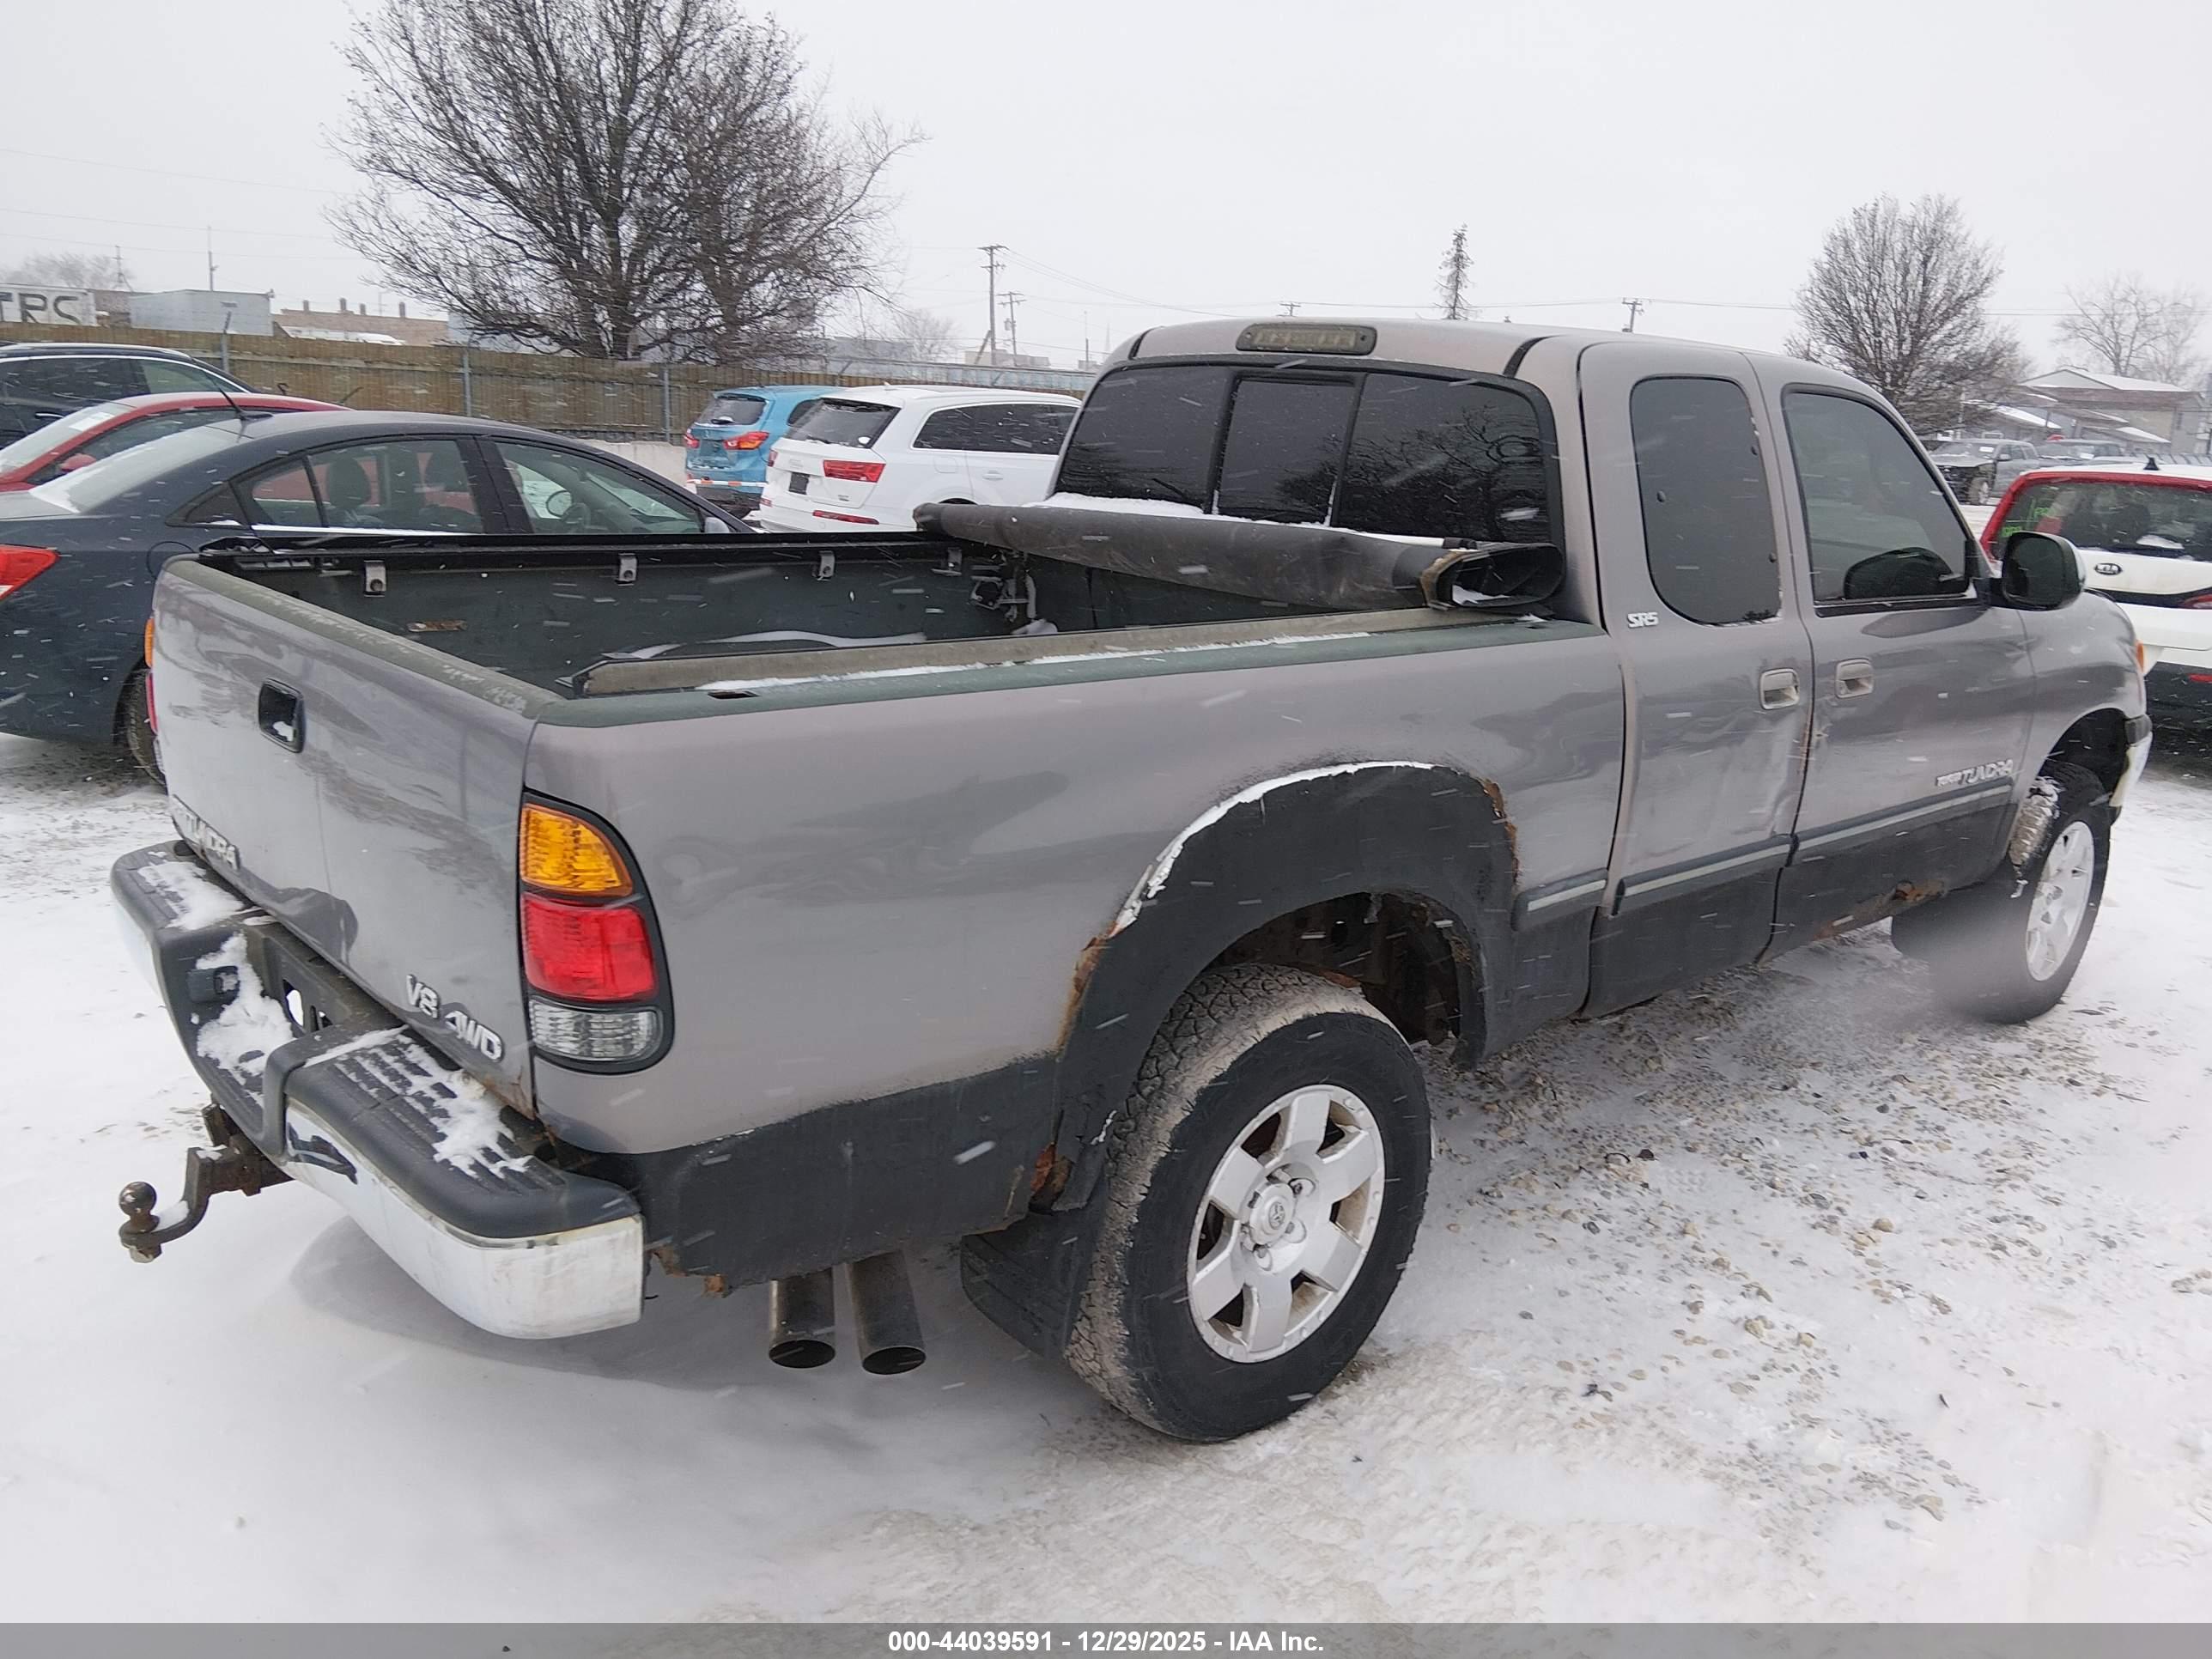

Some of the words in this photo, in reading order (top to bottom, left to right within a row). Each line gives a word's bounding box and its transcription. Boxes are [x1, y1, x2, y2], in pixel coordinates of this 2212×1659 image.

[1627, 611, 1659, 628] SR5
[406, 974, 440, 1018] V8
[445, 1010, 504, 1061] 4WD
